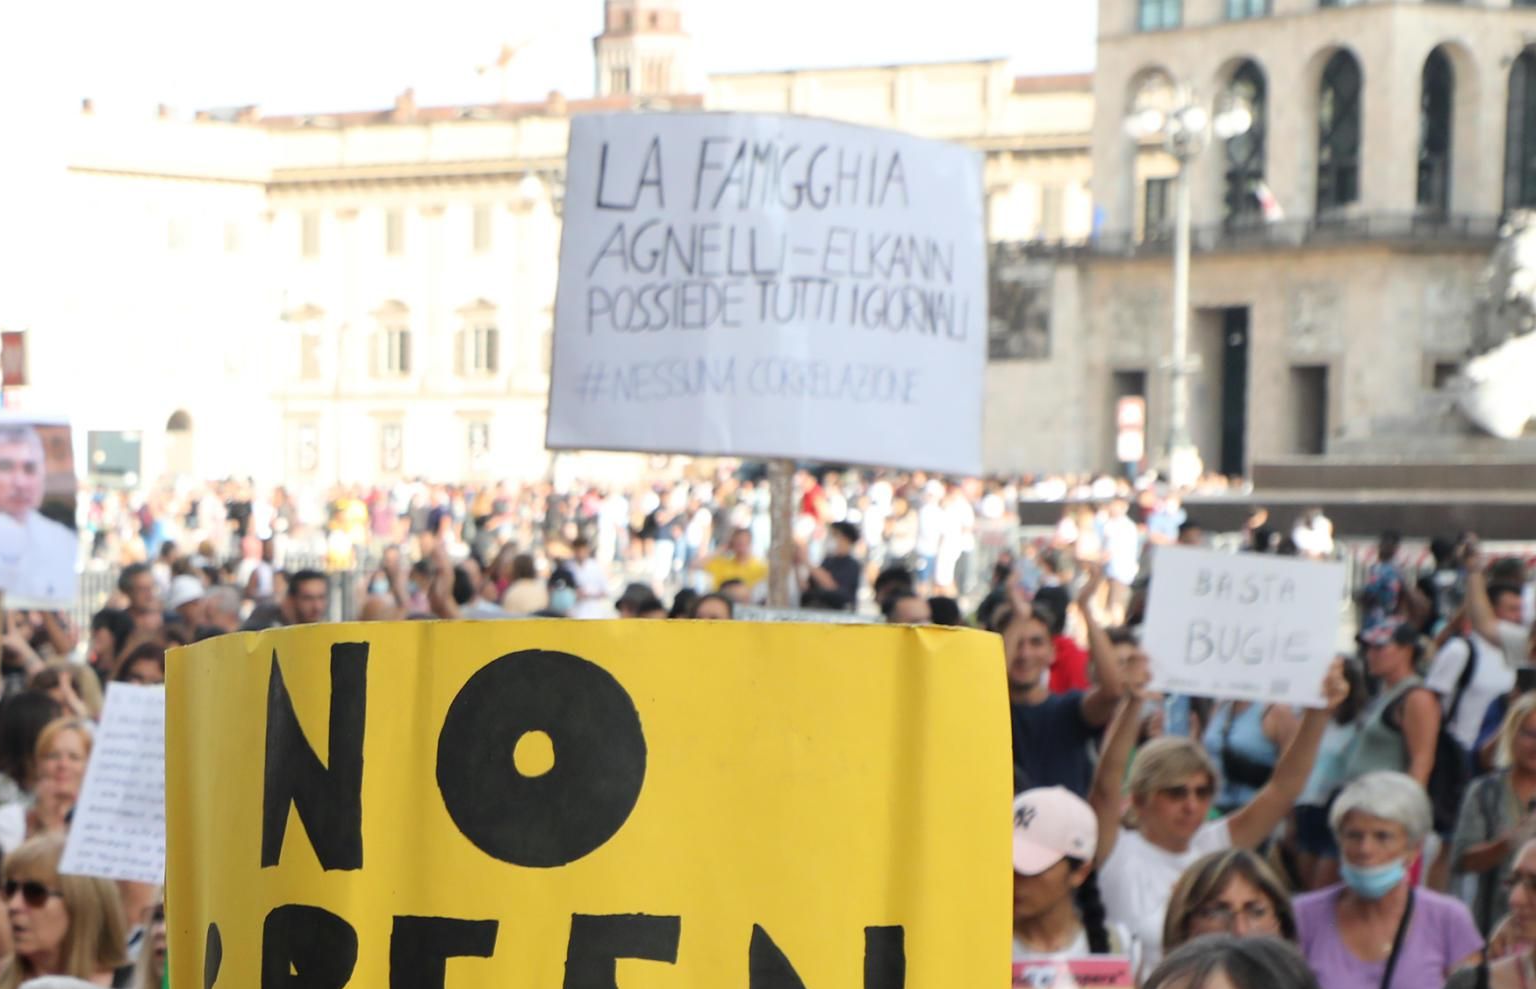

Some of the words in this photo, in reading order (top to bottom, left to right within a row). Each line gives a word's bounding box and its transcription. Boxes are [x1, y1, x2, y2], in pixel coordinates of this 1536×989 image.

[595, 136, 665, 211] LA
[586, 281, 743, 335] POSSIEDE
[755, 275, 839, 325] TUTTI
[1193, 568, 1296, 604] BASTA
[1184, 619, 1311, 666] BUGIE
[261, 641, 648, 872] NO
